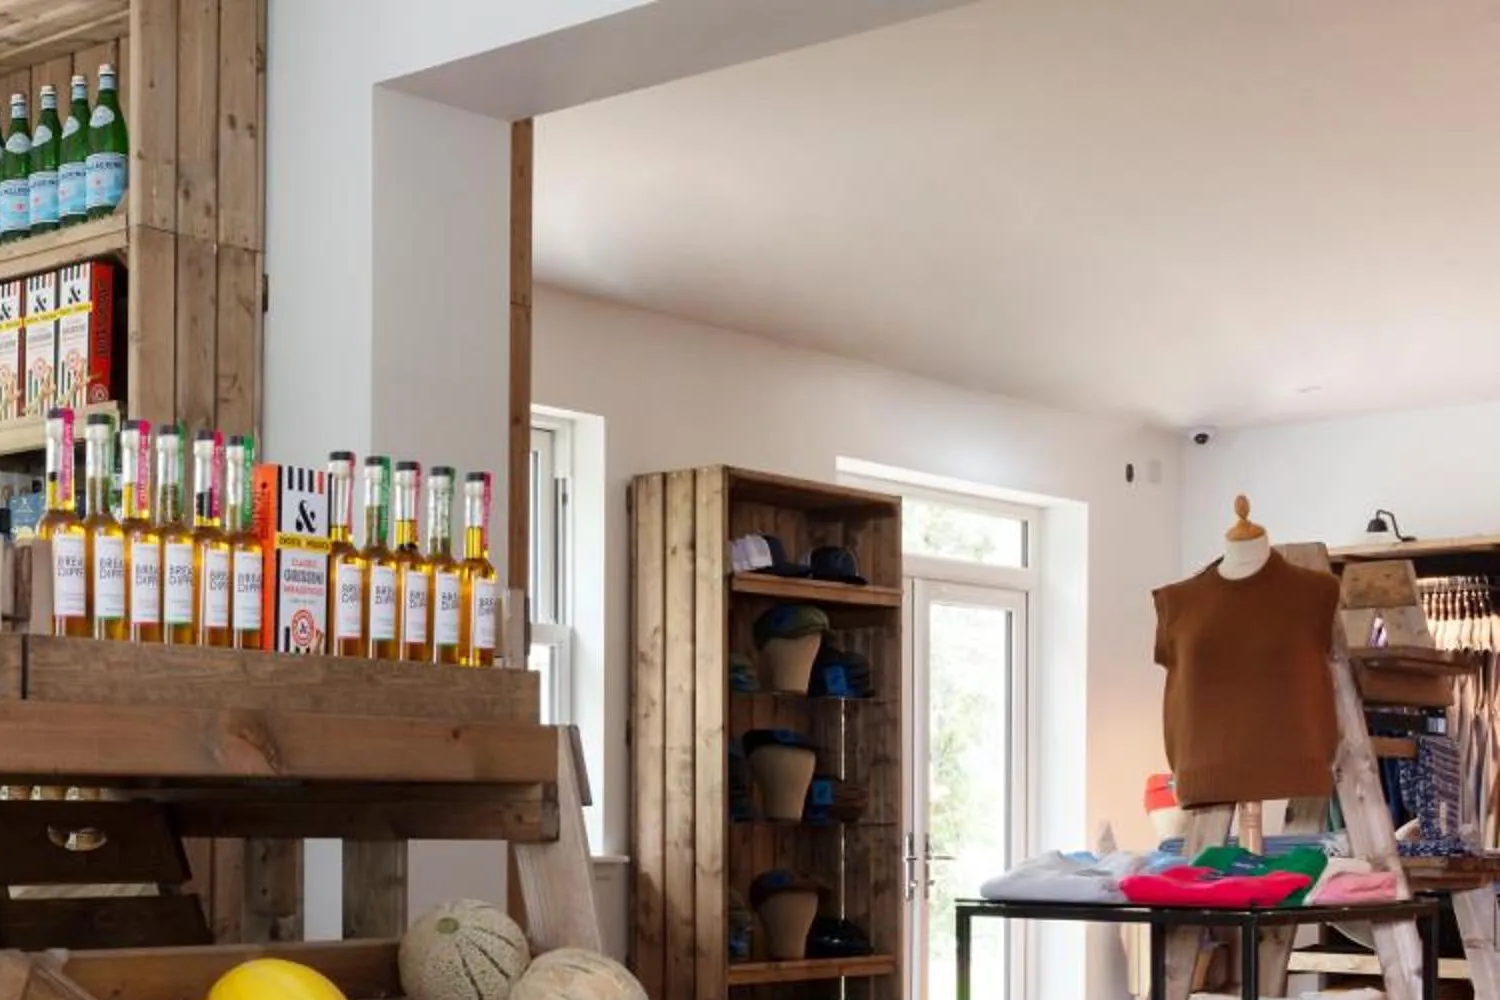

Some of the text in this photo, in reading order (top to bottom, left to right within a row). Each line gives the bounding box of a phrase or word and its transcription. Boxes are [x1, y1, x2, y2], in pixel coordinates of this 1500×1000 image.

[294, 499, 317, 533] &
[57, 555, 84, 567] BREA
[99, 557, 124, 569] BREA
